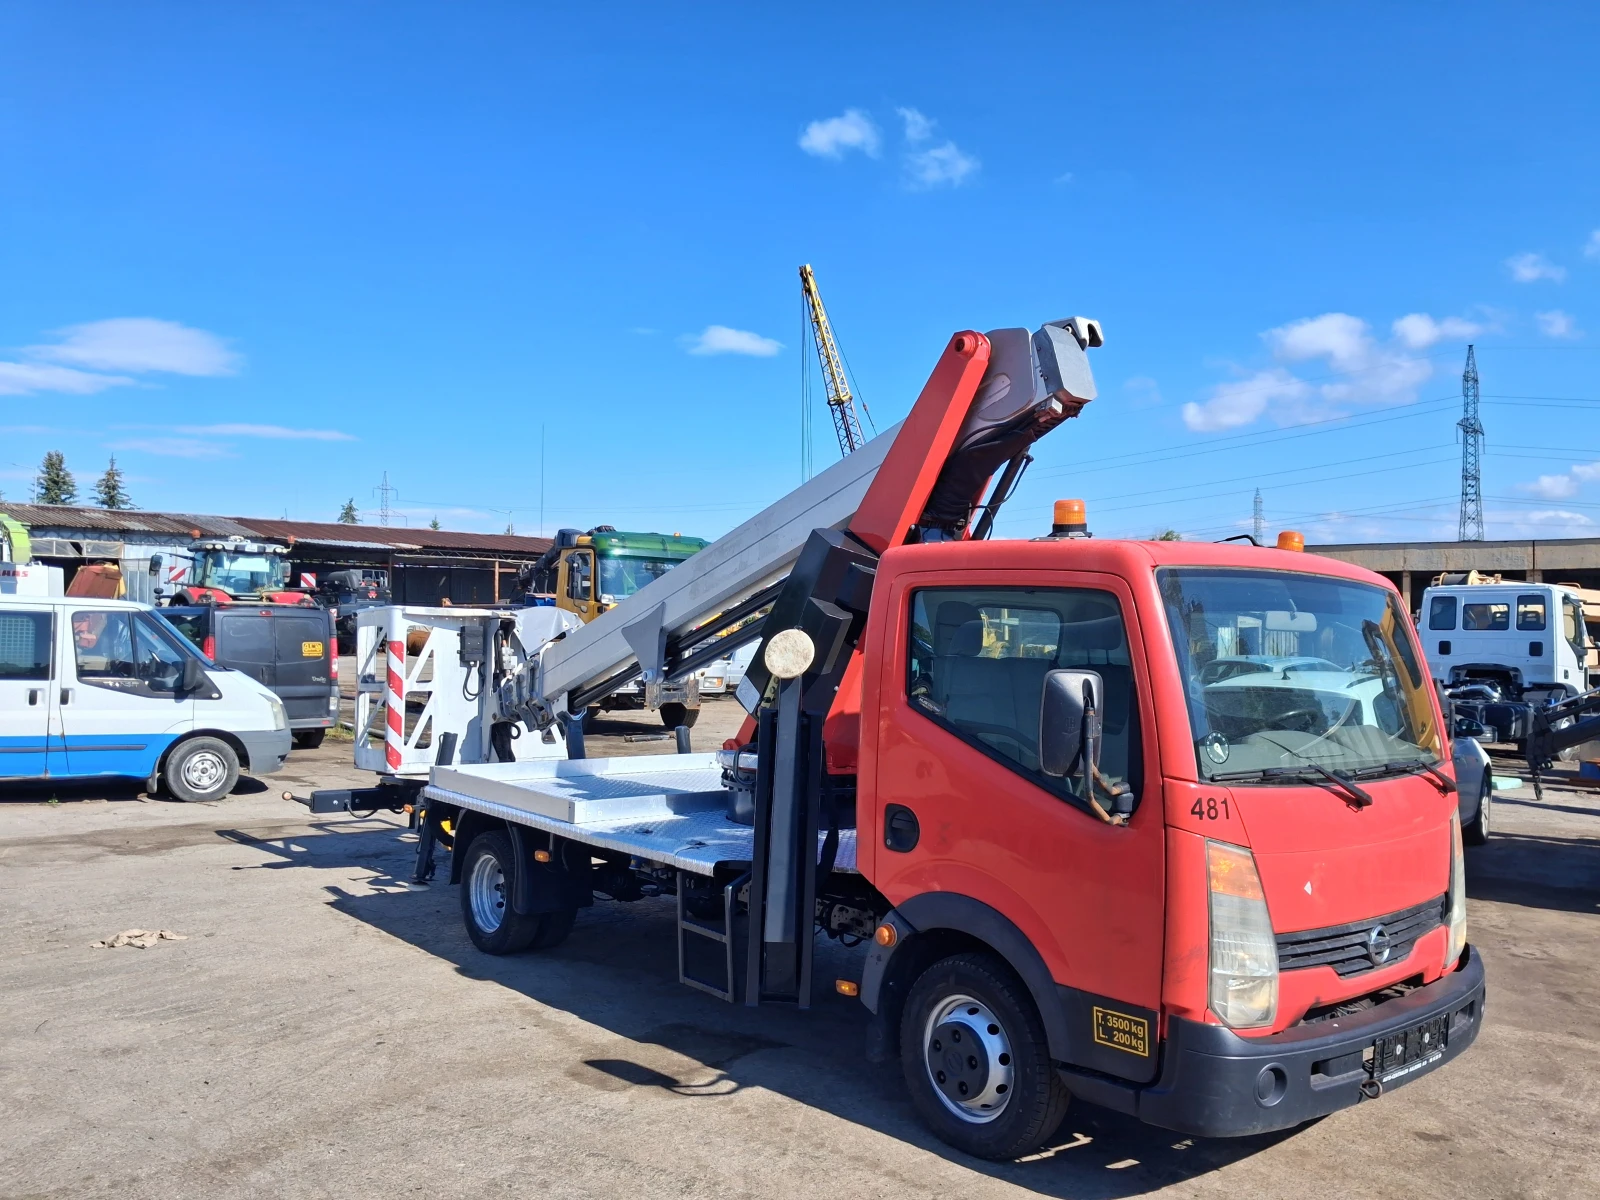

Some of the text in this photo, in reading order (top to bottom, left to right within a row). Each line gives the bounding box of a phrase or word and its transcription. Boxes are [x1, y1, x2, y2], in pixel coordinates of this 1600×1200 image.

[1190, 797, 1230, 820] 481
[1096, 1012, 1144, 1038] T. 3500 kg
[1099, 1026, 1144, 1051] L. 200 kg
